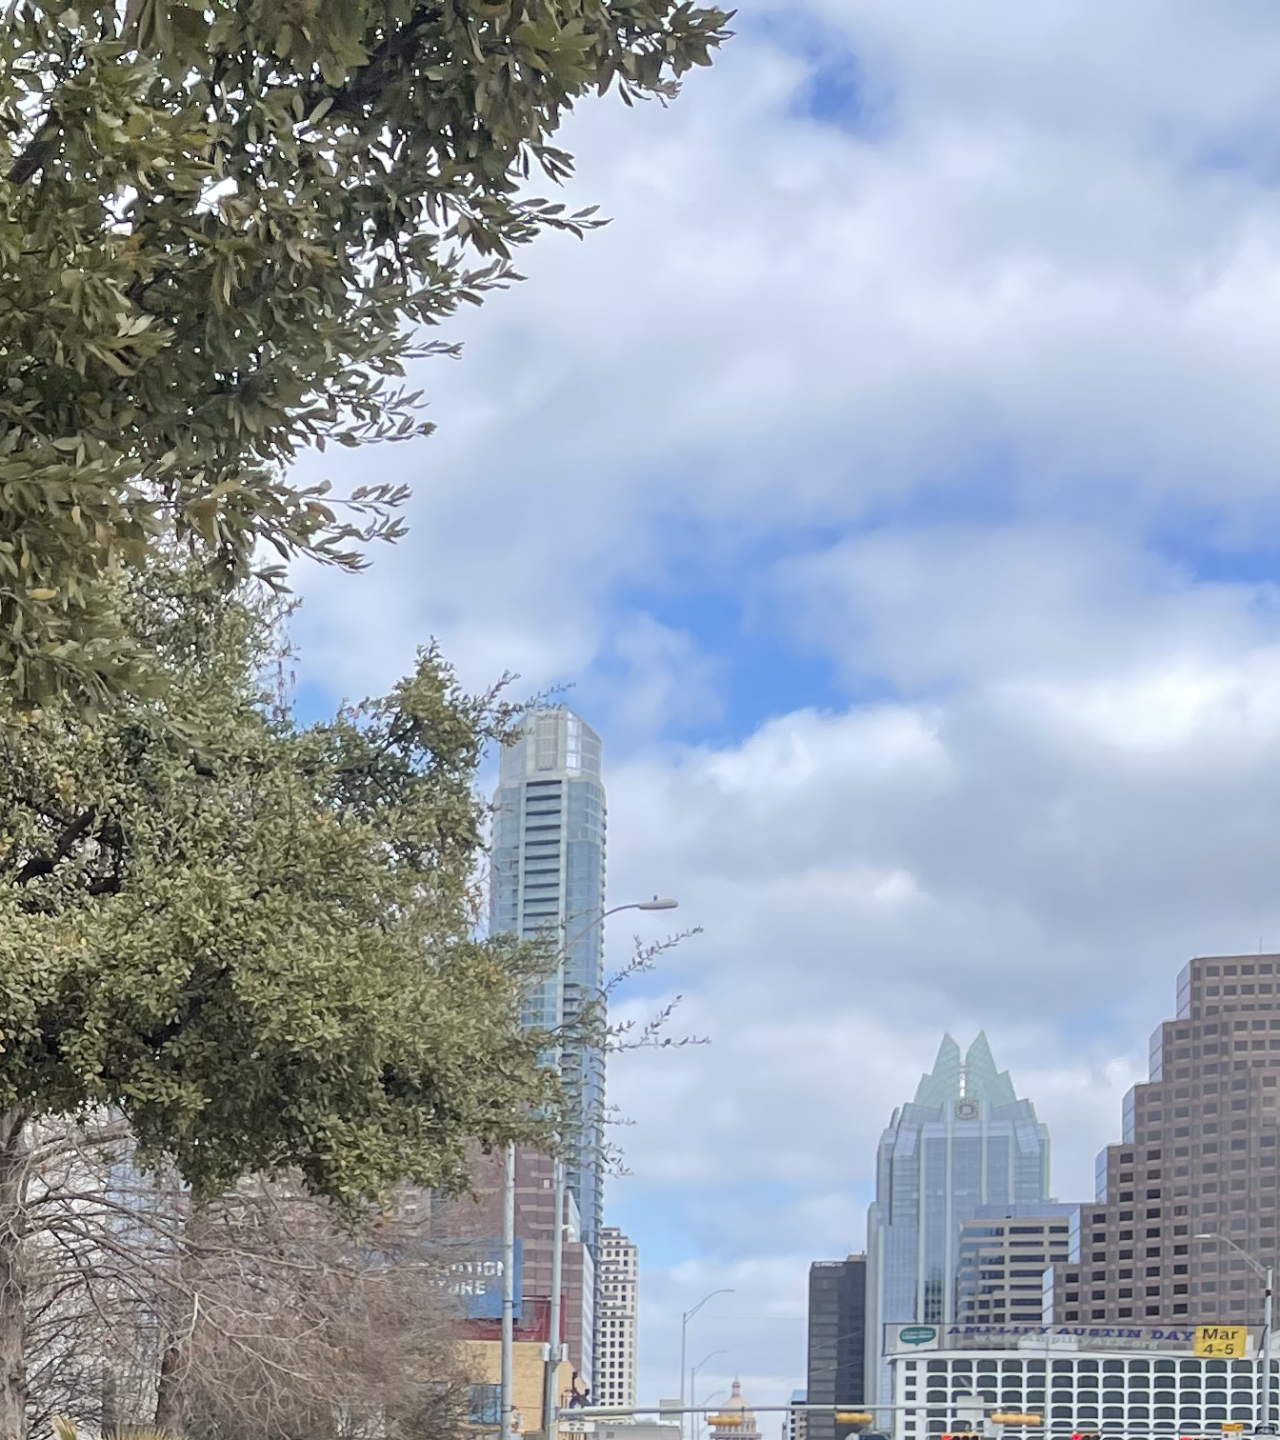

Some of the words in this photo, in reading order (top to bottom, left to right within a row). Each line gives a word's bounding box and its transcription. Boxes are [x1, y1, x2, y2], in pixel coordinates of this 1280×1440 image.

[1056, 1327, 1143, 1338] AUSTIN
[1150, 1329, 1195, 1341] DAY
[1202, 1328, 1239, 1339] Mar
[1203, 1343, 1235, 1355] 4-5
